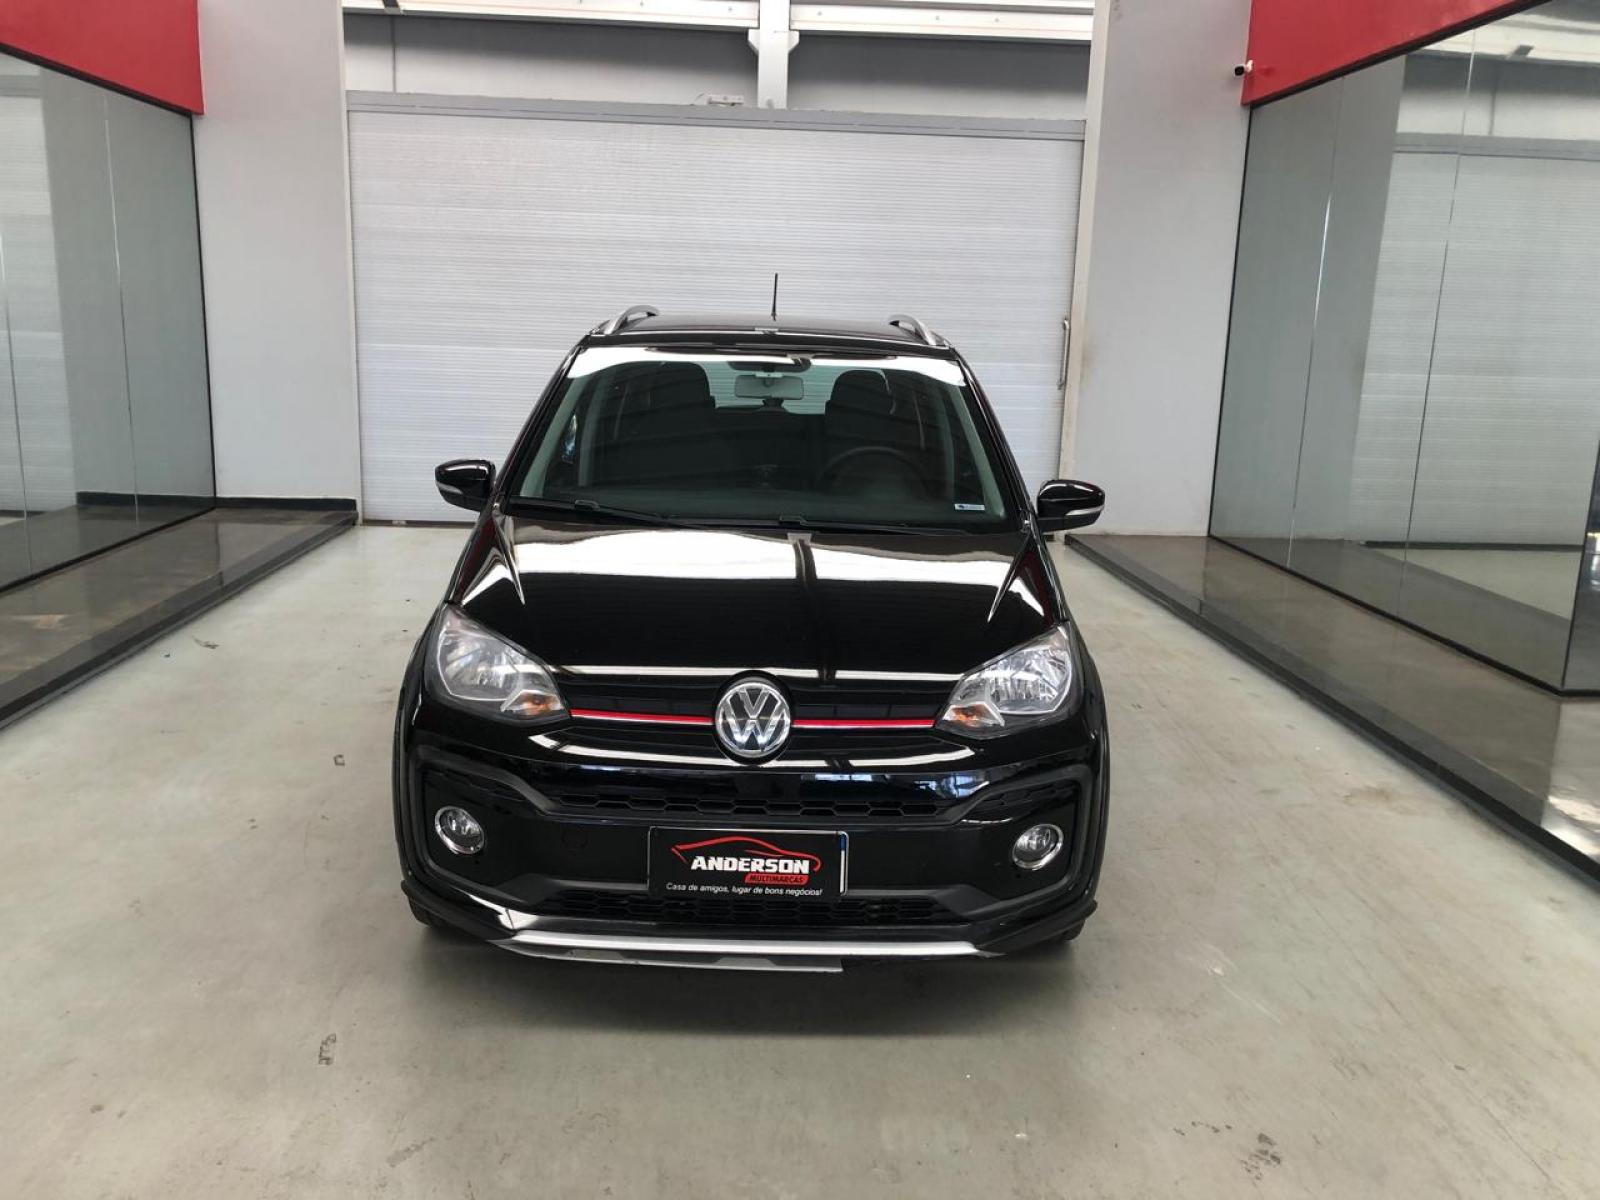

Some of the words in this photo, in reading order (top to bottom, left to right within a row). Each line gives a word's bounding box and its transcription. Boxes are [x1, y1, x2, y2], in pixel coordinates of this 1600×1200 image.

[691, 856, 809, 874] ANDERSON
[749, 874, 806, 884] MULTIMARCAS
[666, 882, 687, 891] Casa
[688, 883, 698, 891] de
[700, 885, 729, 894] amigos,
[732, 885, 751, 895] lugar
[753, 886, 764, 895] de
[765, 887, 784, 895] bons
[785, 888, 823, 897] negócios!
